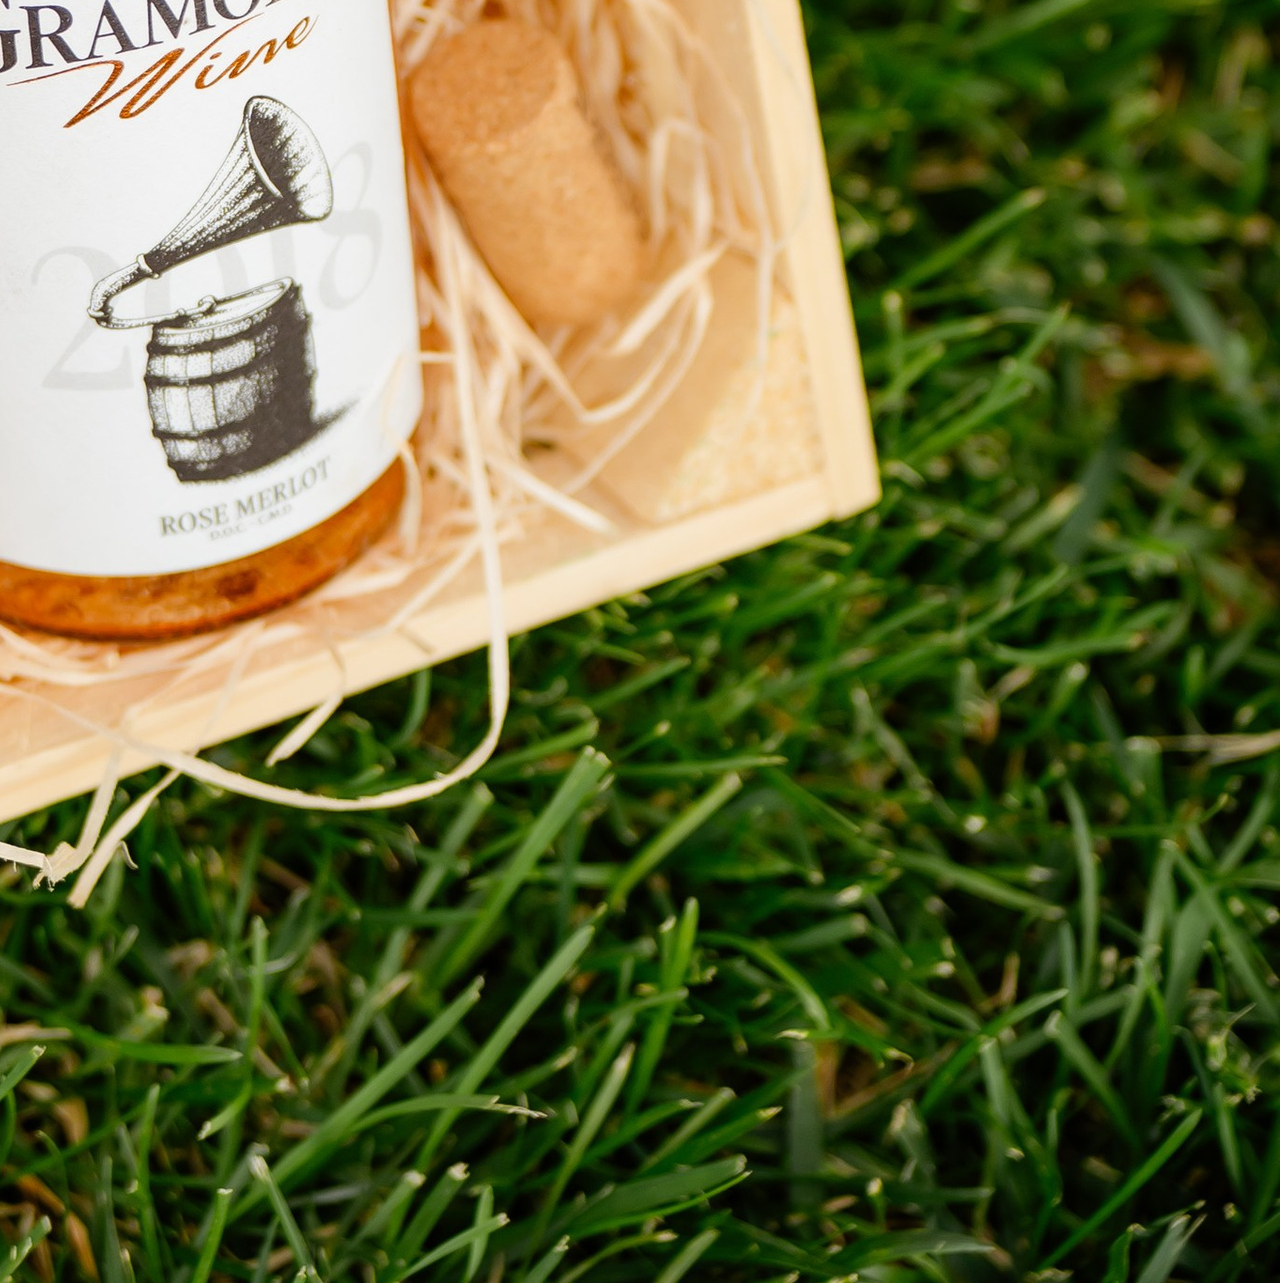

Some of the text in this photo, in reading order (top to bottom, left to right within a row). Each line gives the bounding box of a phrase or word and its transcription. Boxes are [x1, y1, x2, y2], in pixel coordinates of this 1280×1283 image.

[6, 12, 320, 129] Wine
[160, 455, 332, 537] ROSE MERLOT
